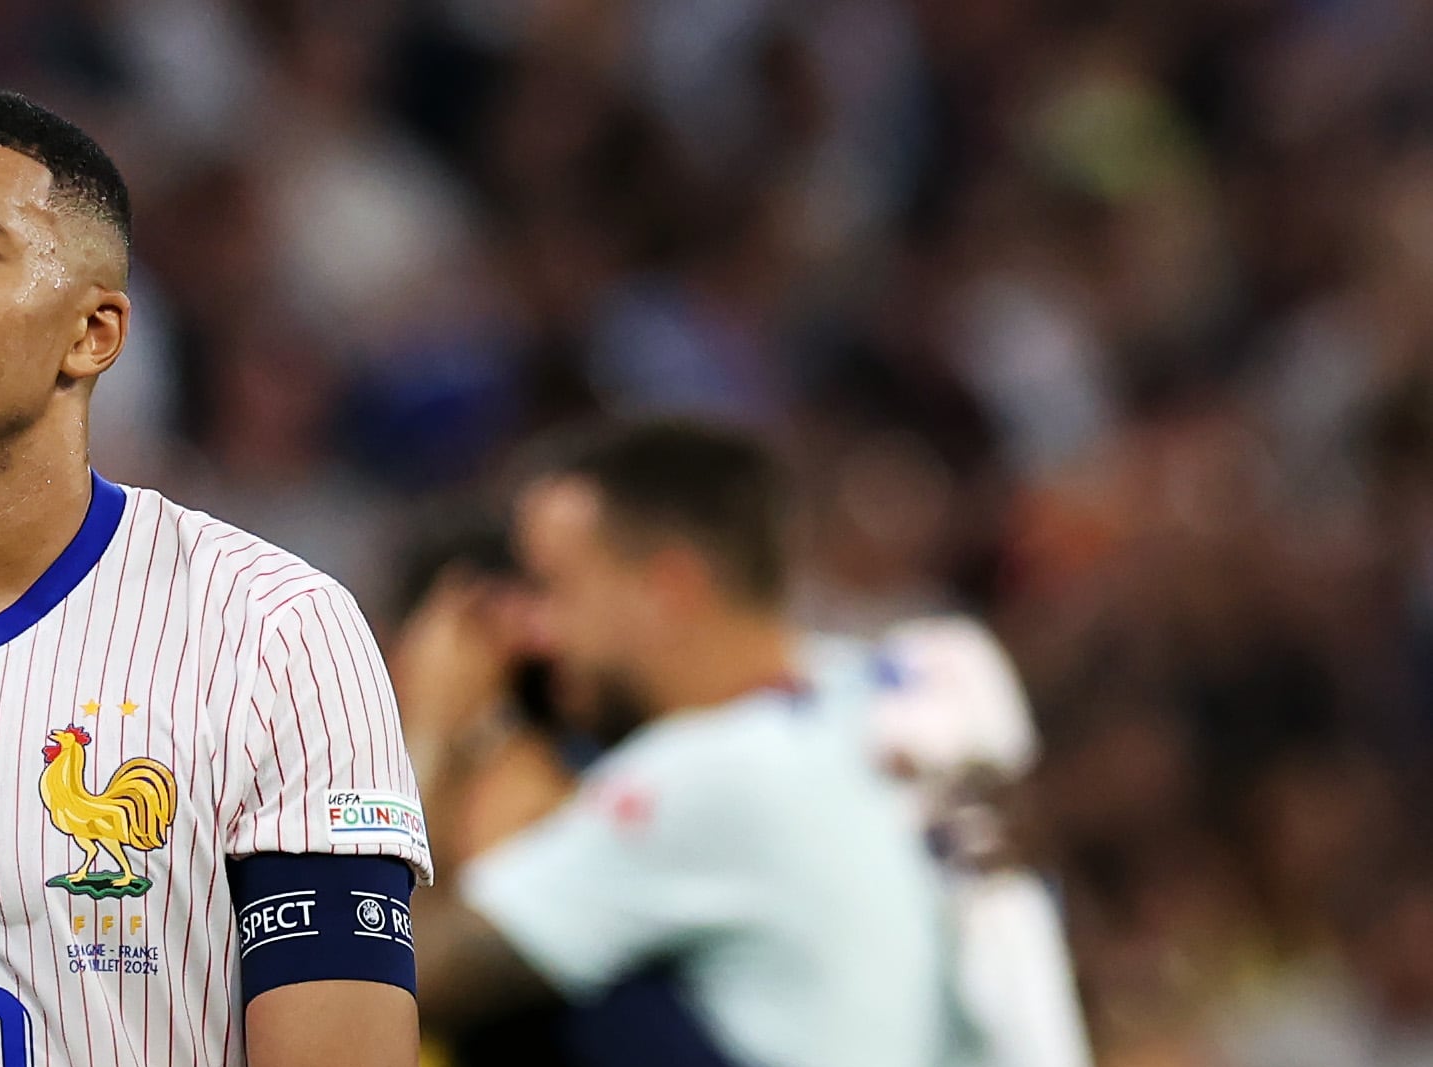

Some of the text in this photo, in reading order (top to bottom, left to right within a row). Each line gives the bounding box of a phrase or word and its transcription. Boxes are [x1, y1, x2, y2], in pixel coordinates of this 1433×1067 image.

[328, 793, 360, 806] UEFA
[240, 900, 316, 947] SPECT
[392, 908, 414, 943] RE
[119, 944, 159, 960] FRANCE
[124, 960, 159, 976] 2024
